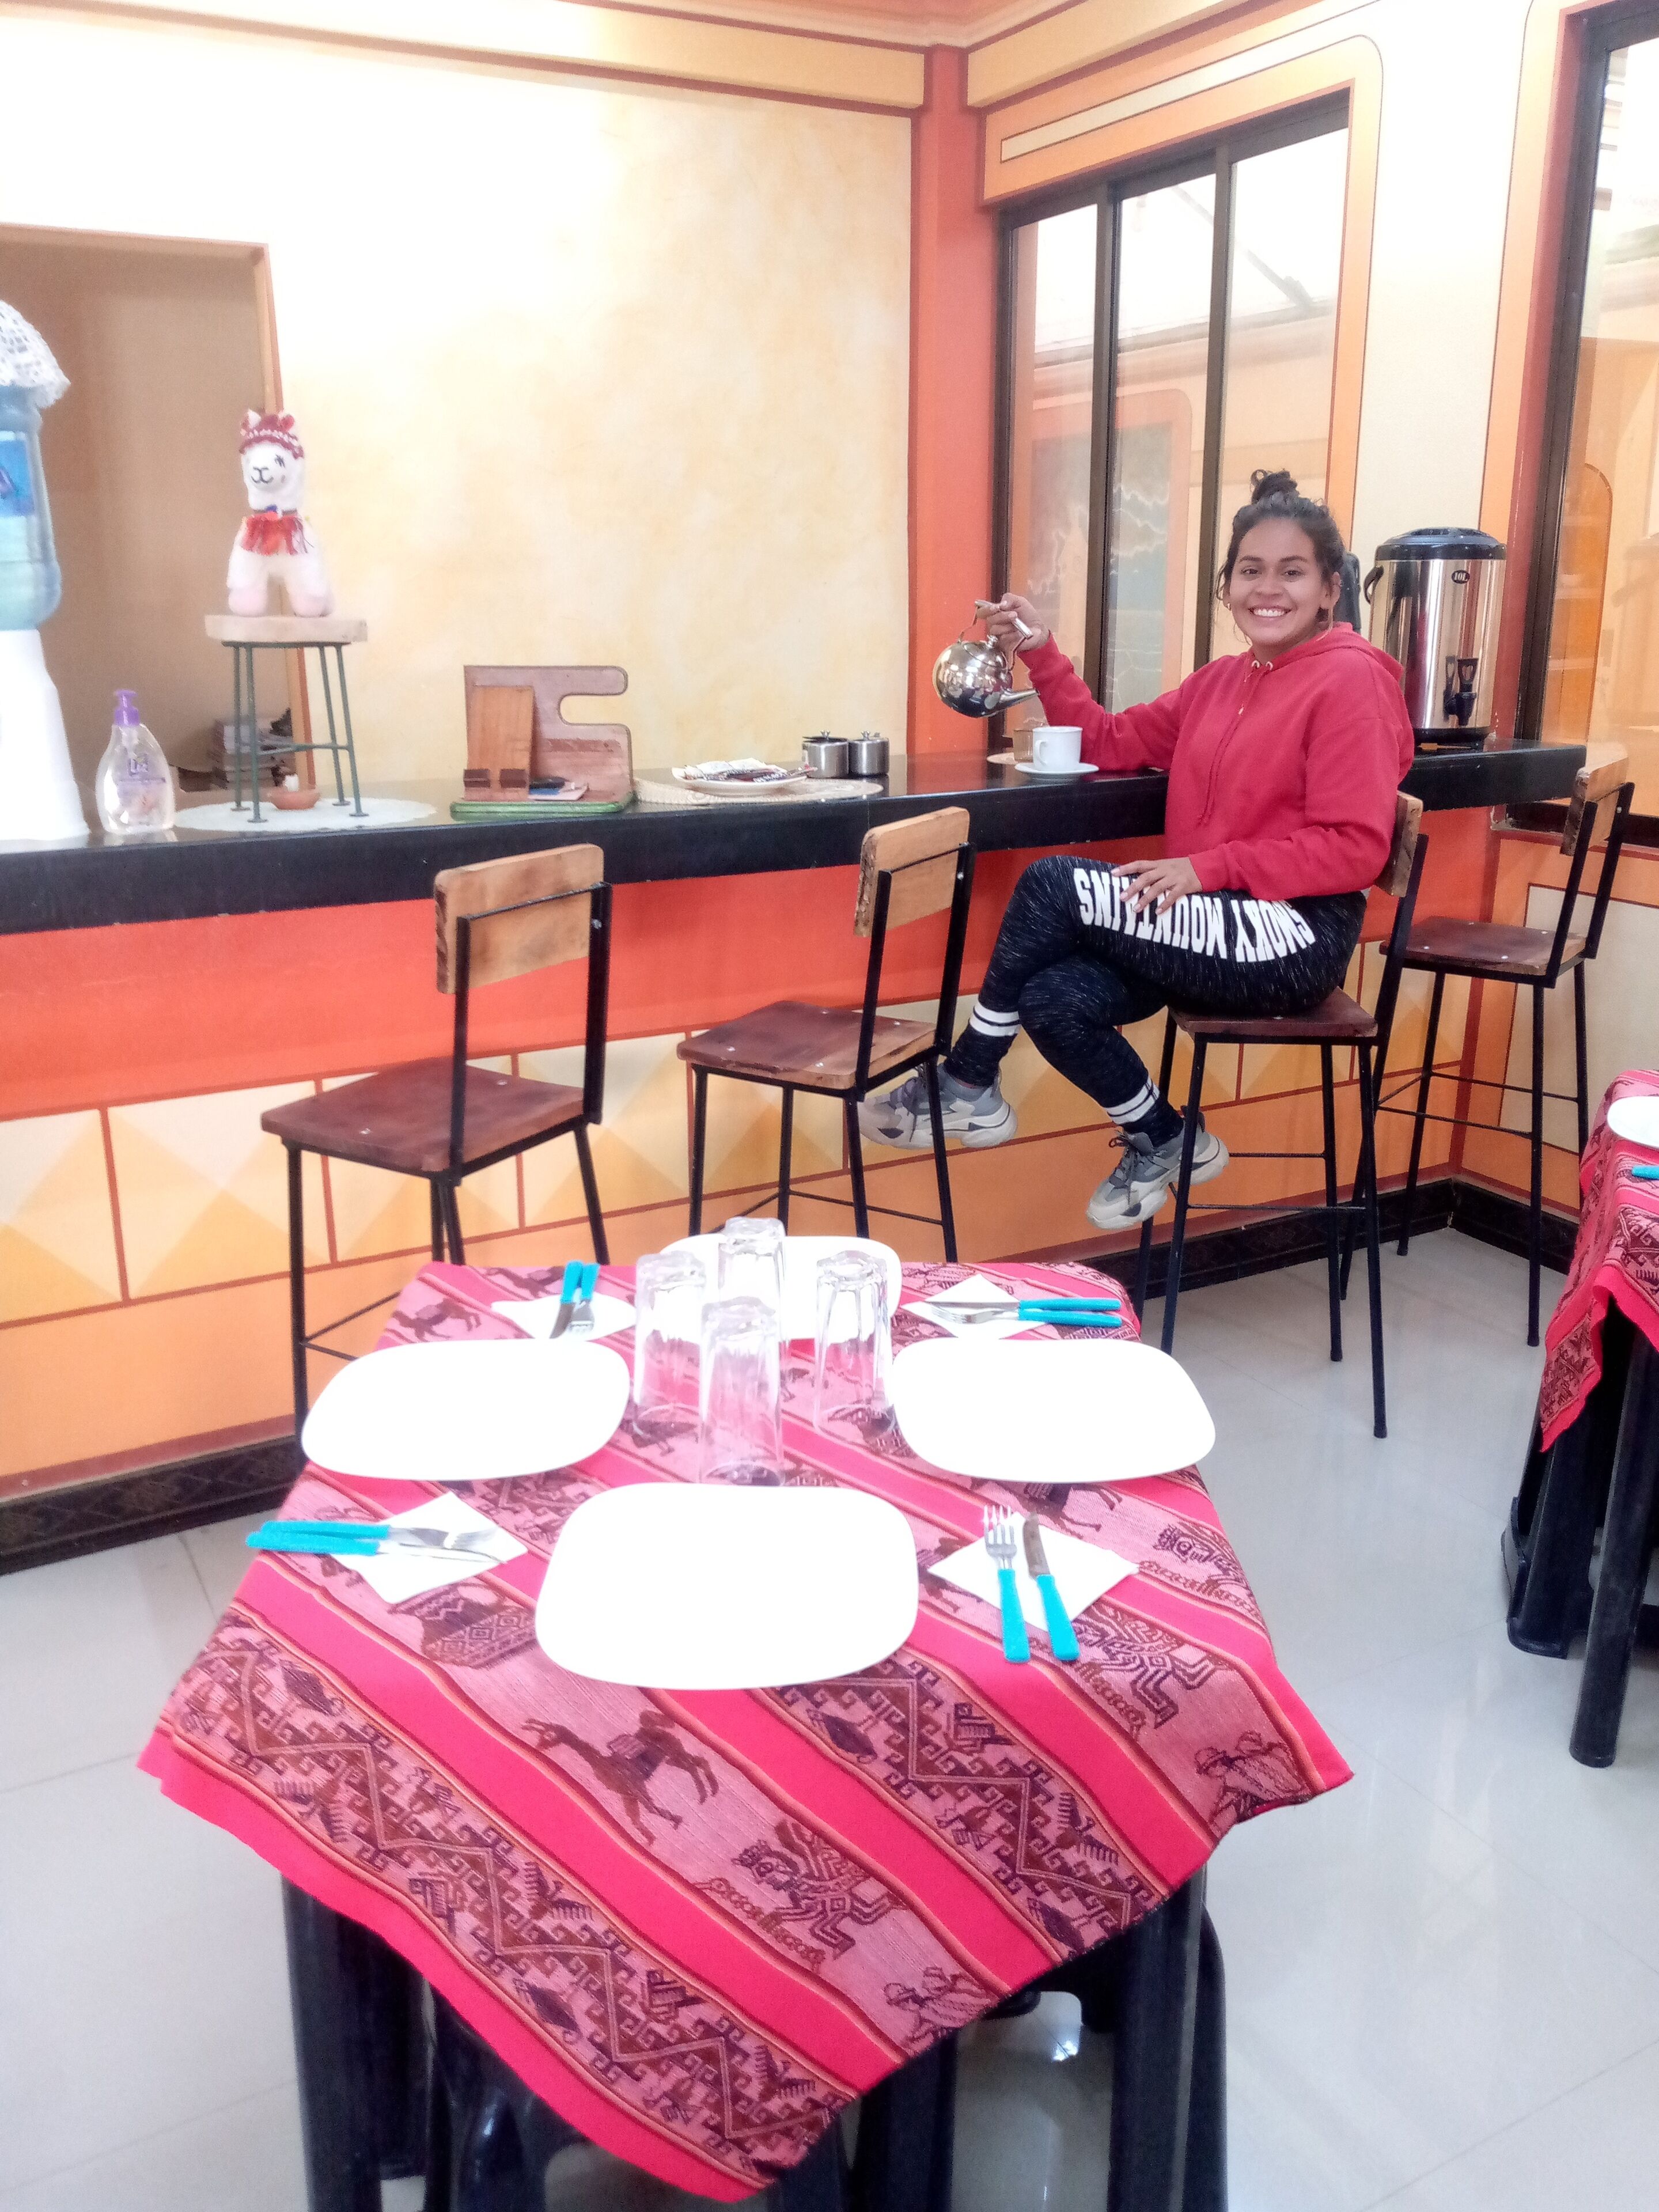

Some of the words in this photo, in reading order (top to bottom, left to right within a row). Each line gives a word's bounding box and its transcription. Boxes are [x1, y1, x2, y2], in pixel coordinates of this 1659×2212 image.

[1454, 572, 1468, 581] 10L
[1073, 868, 1228, 959] MOUNTAINS
[1230, 899, 1316, 963] SMOKY
